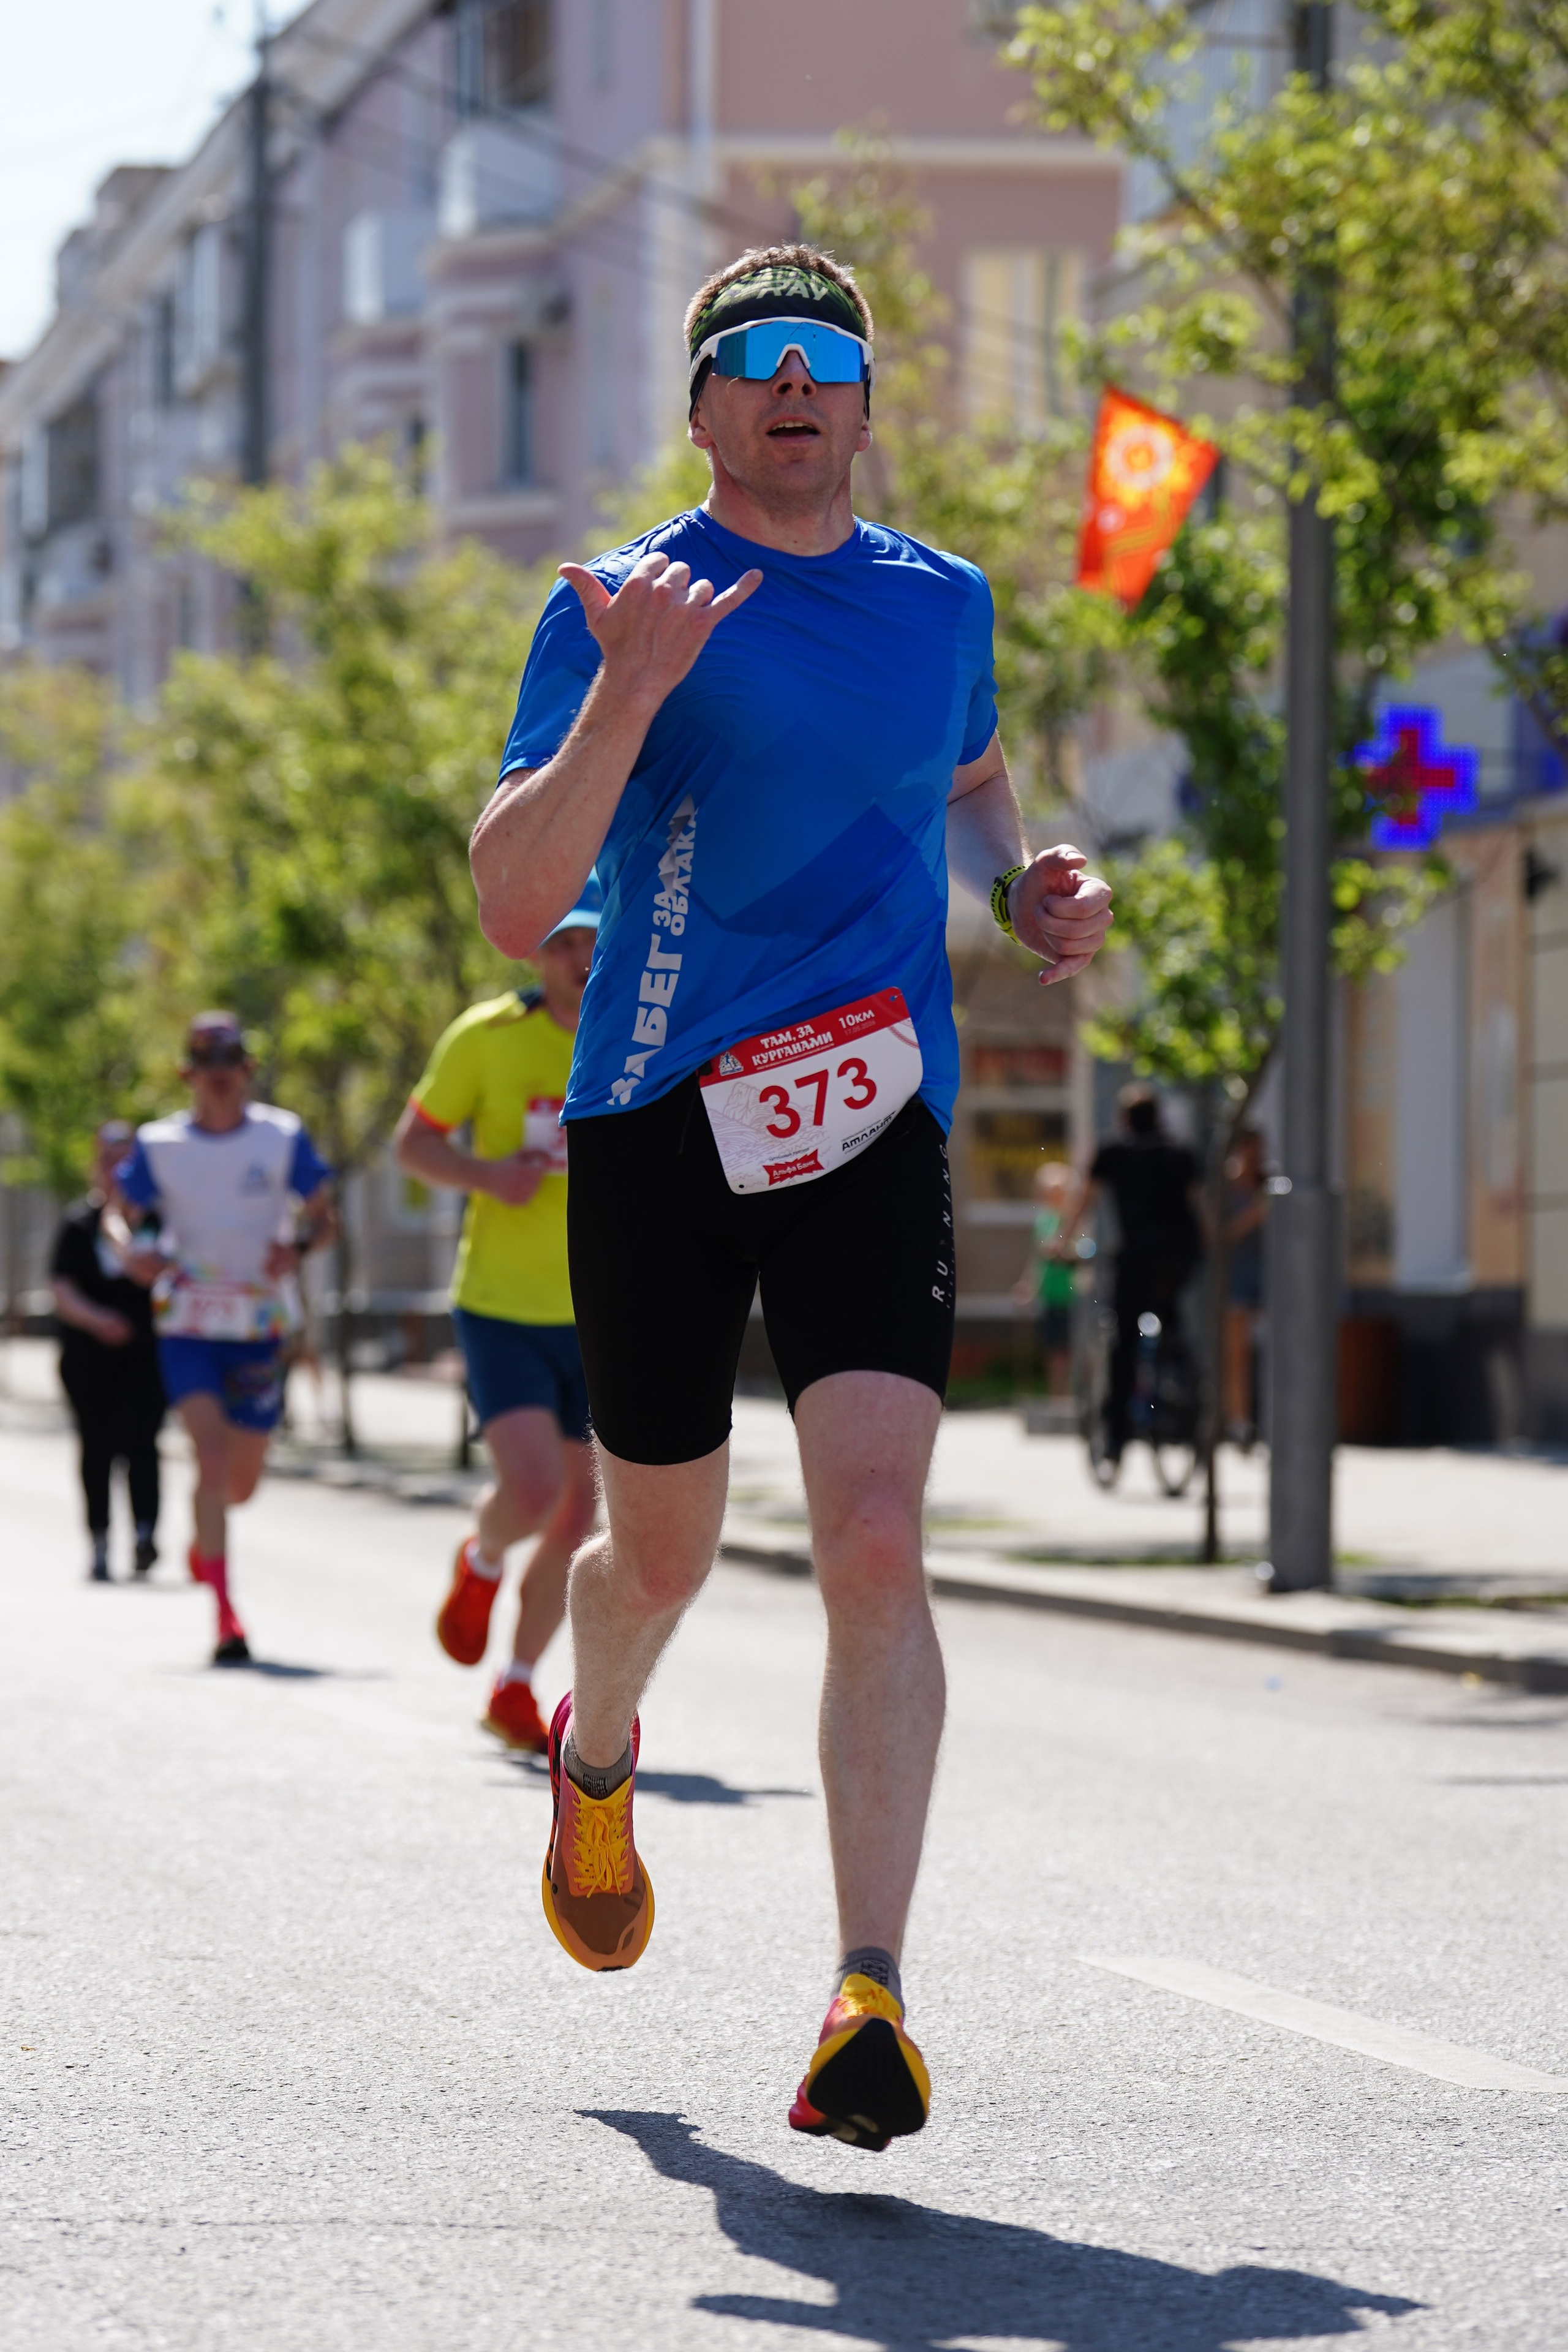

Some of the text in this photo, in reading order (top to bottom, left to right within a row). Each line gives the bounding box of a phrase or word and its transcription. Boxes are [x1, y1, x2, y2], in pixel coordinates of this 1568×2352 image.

[606, 891, 683, 1106] ЗАБЕГ ЗА
[760, 1024, 815, 1049] ТАМ, ЗА
[752, 1031, 834, 1066] КУРГАНАМИ
[759, 1058, 877, 1139] 373
[932, 1144, 951, 1303] RUNING
